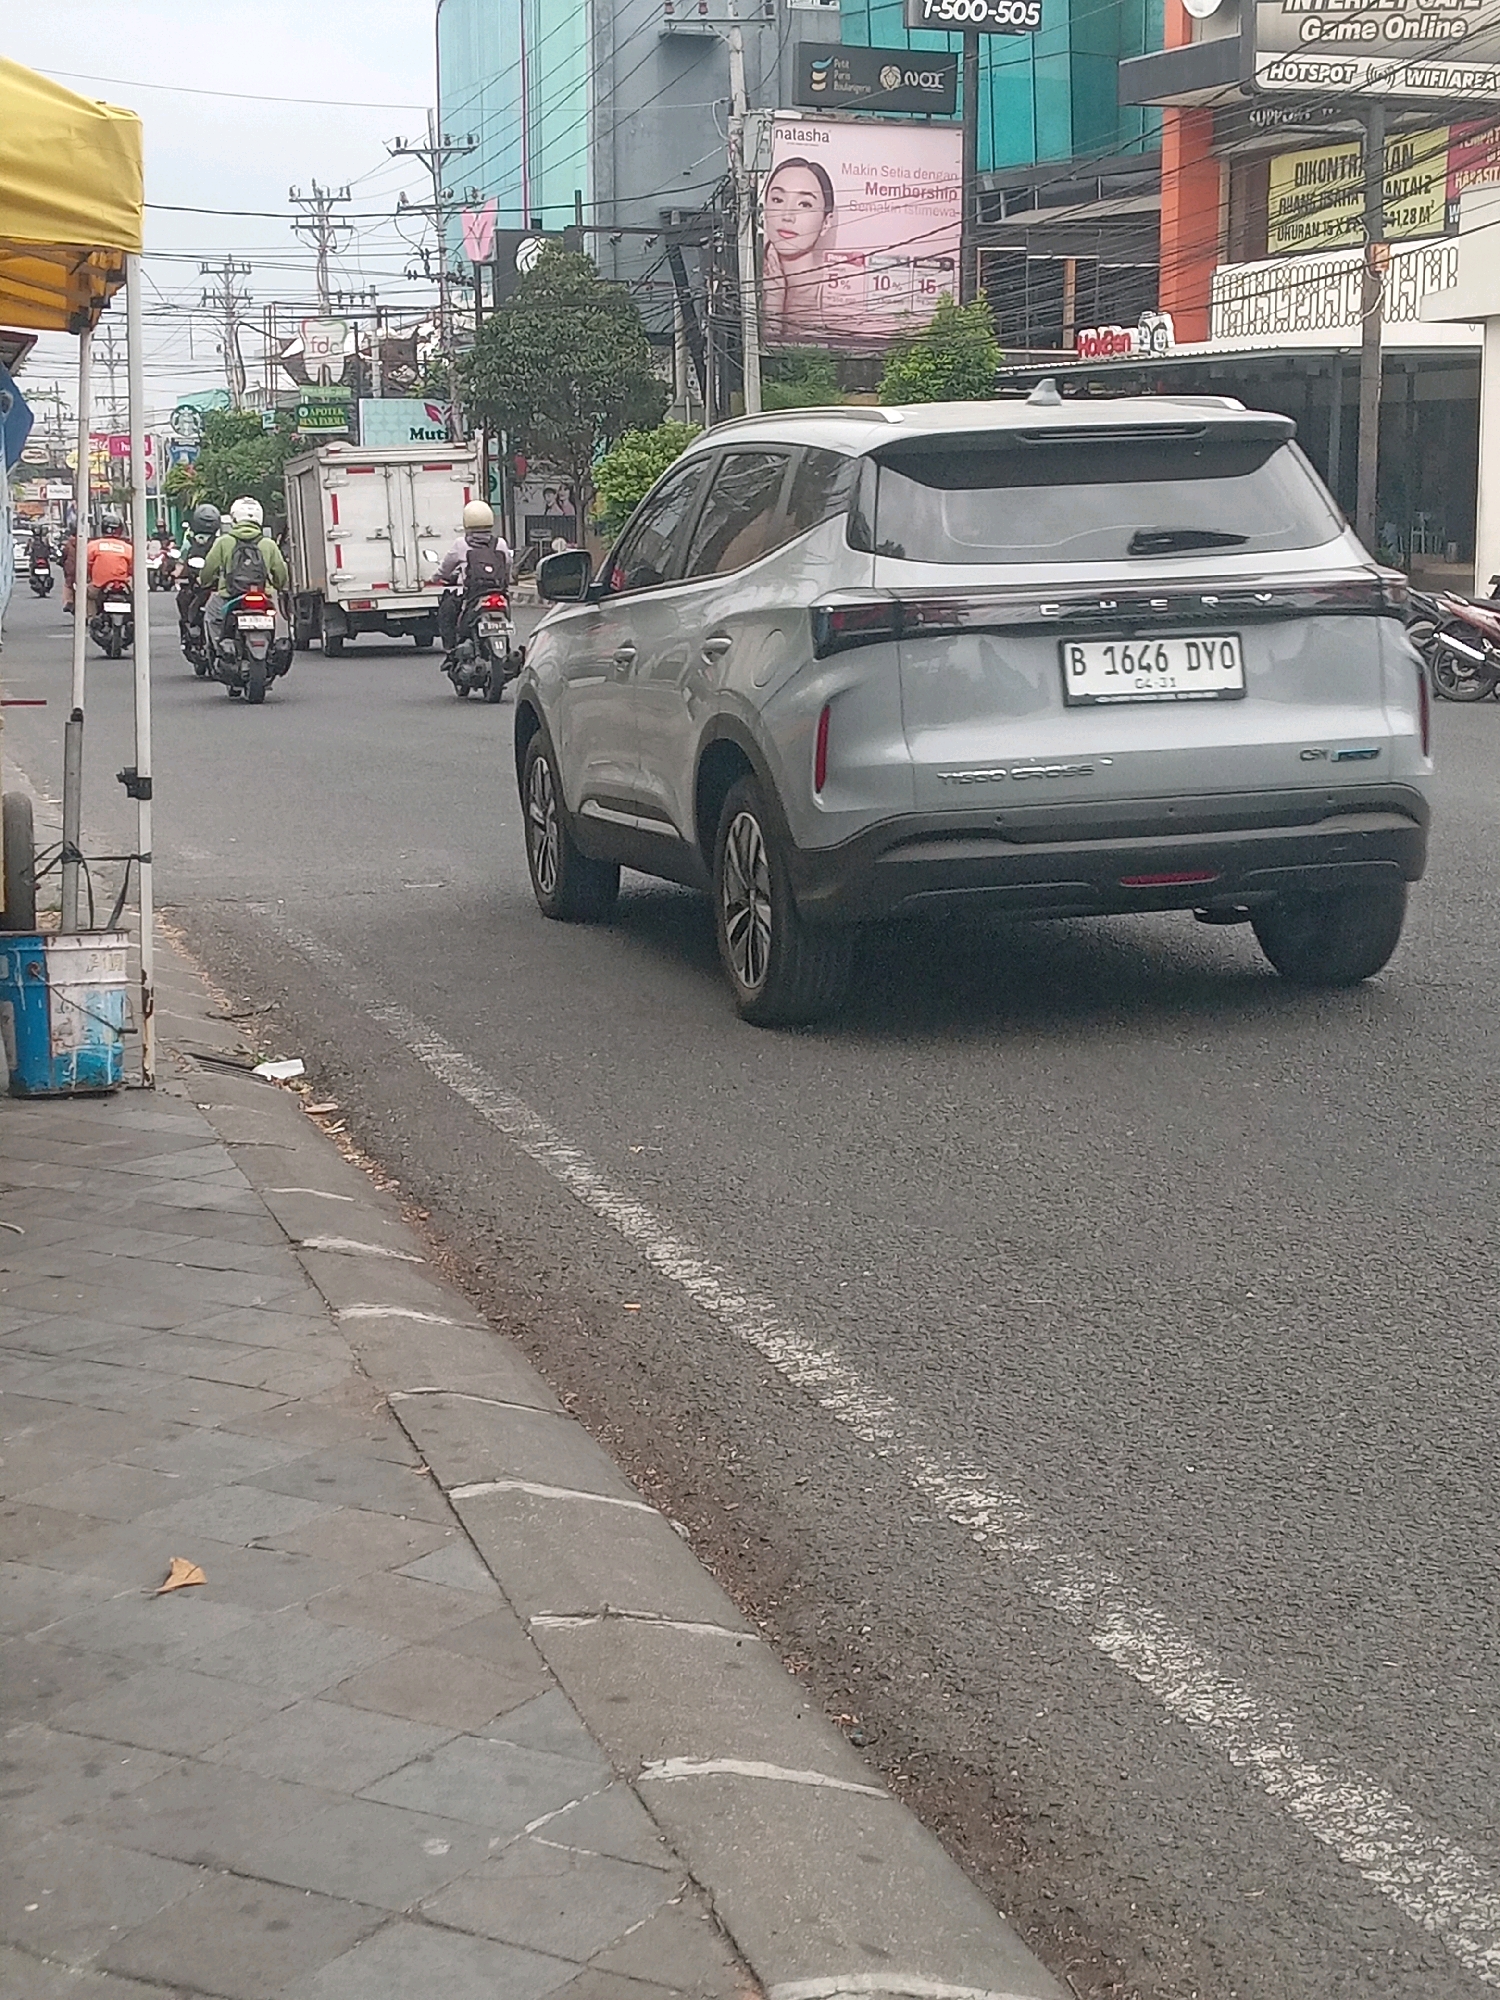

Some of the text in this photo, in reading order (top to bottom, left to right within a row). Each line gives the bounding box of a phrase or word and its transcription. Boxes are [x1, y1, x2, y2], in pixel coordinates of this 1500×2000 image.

[924, 0, 1041, 25] 1-500-505
[1301, 13, 1468, 42] Game Online
[1268, 61, 1498, 91] HOTSPOT WIFI AREA
[775, 128, 830, 143] natasha
[841, 163, 958, 181] Makin Setia dengan
[865, 182, 958, 203] Membership
[1385, 177, 1423, 198] ANTAI
[311, 336, 340, 354] fdc
[1077, 330, 1131, 358] HokBen
[311, 407, 345, 416] APOTEK
[1071, 640, 1235, 676] B 1646 DYO
